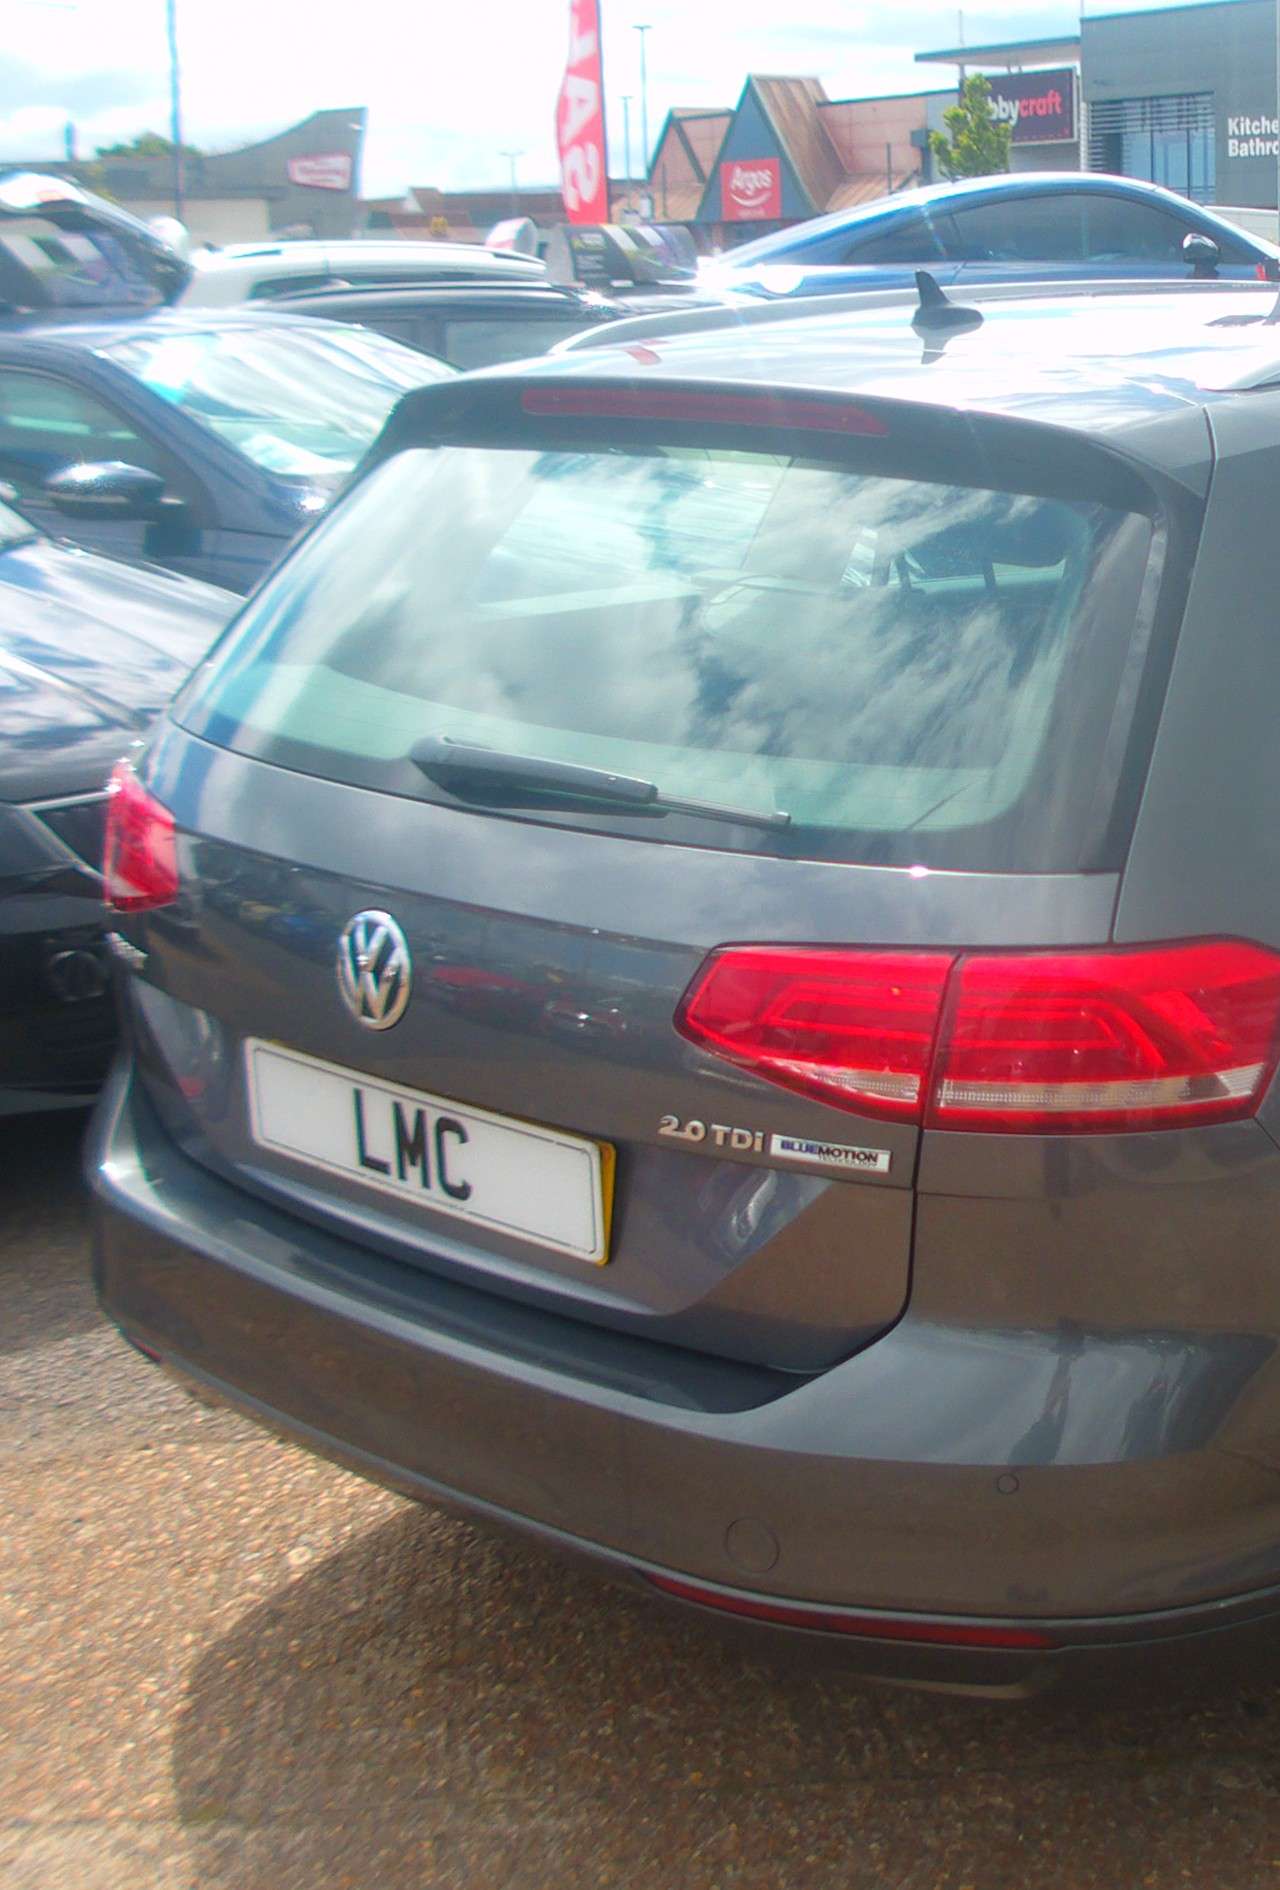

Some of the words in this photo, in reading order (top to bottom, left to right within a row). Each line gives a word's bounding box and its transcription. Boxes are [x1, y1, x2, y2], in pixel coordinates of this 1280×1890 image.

[987, 89, 1062, 127] bycraft
[353, 1087, 473, 1201] LMC
[657, 1114, 706, 1143] 2.0
